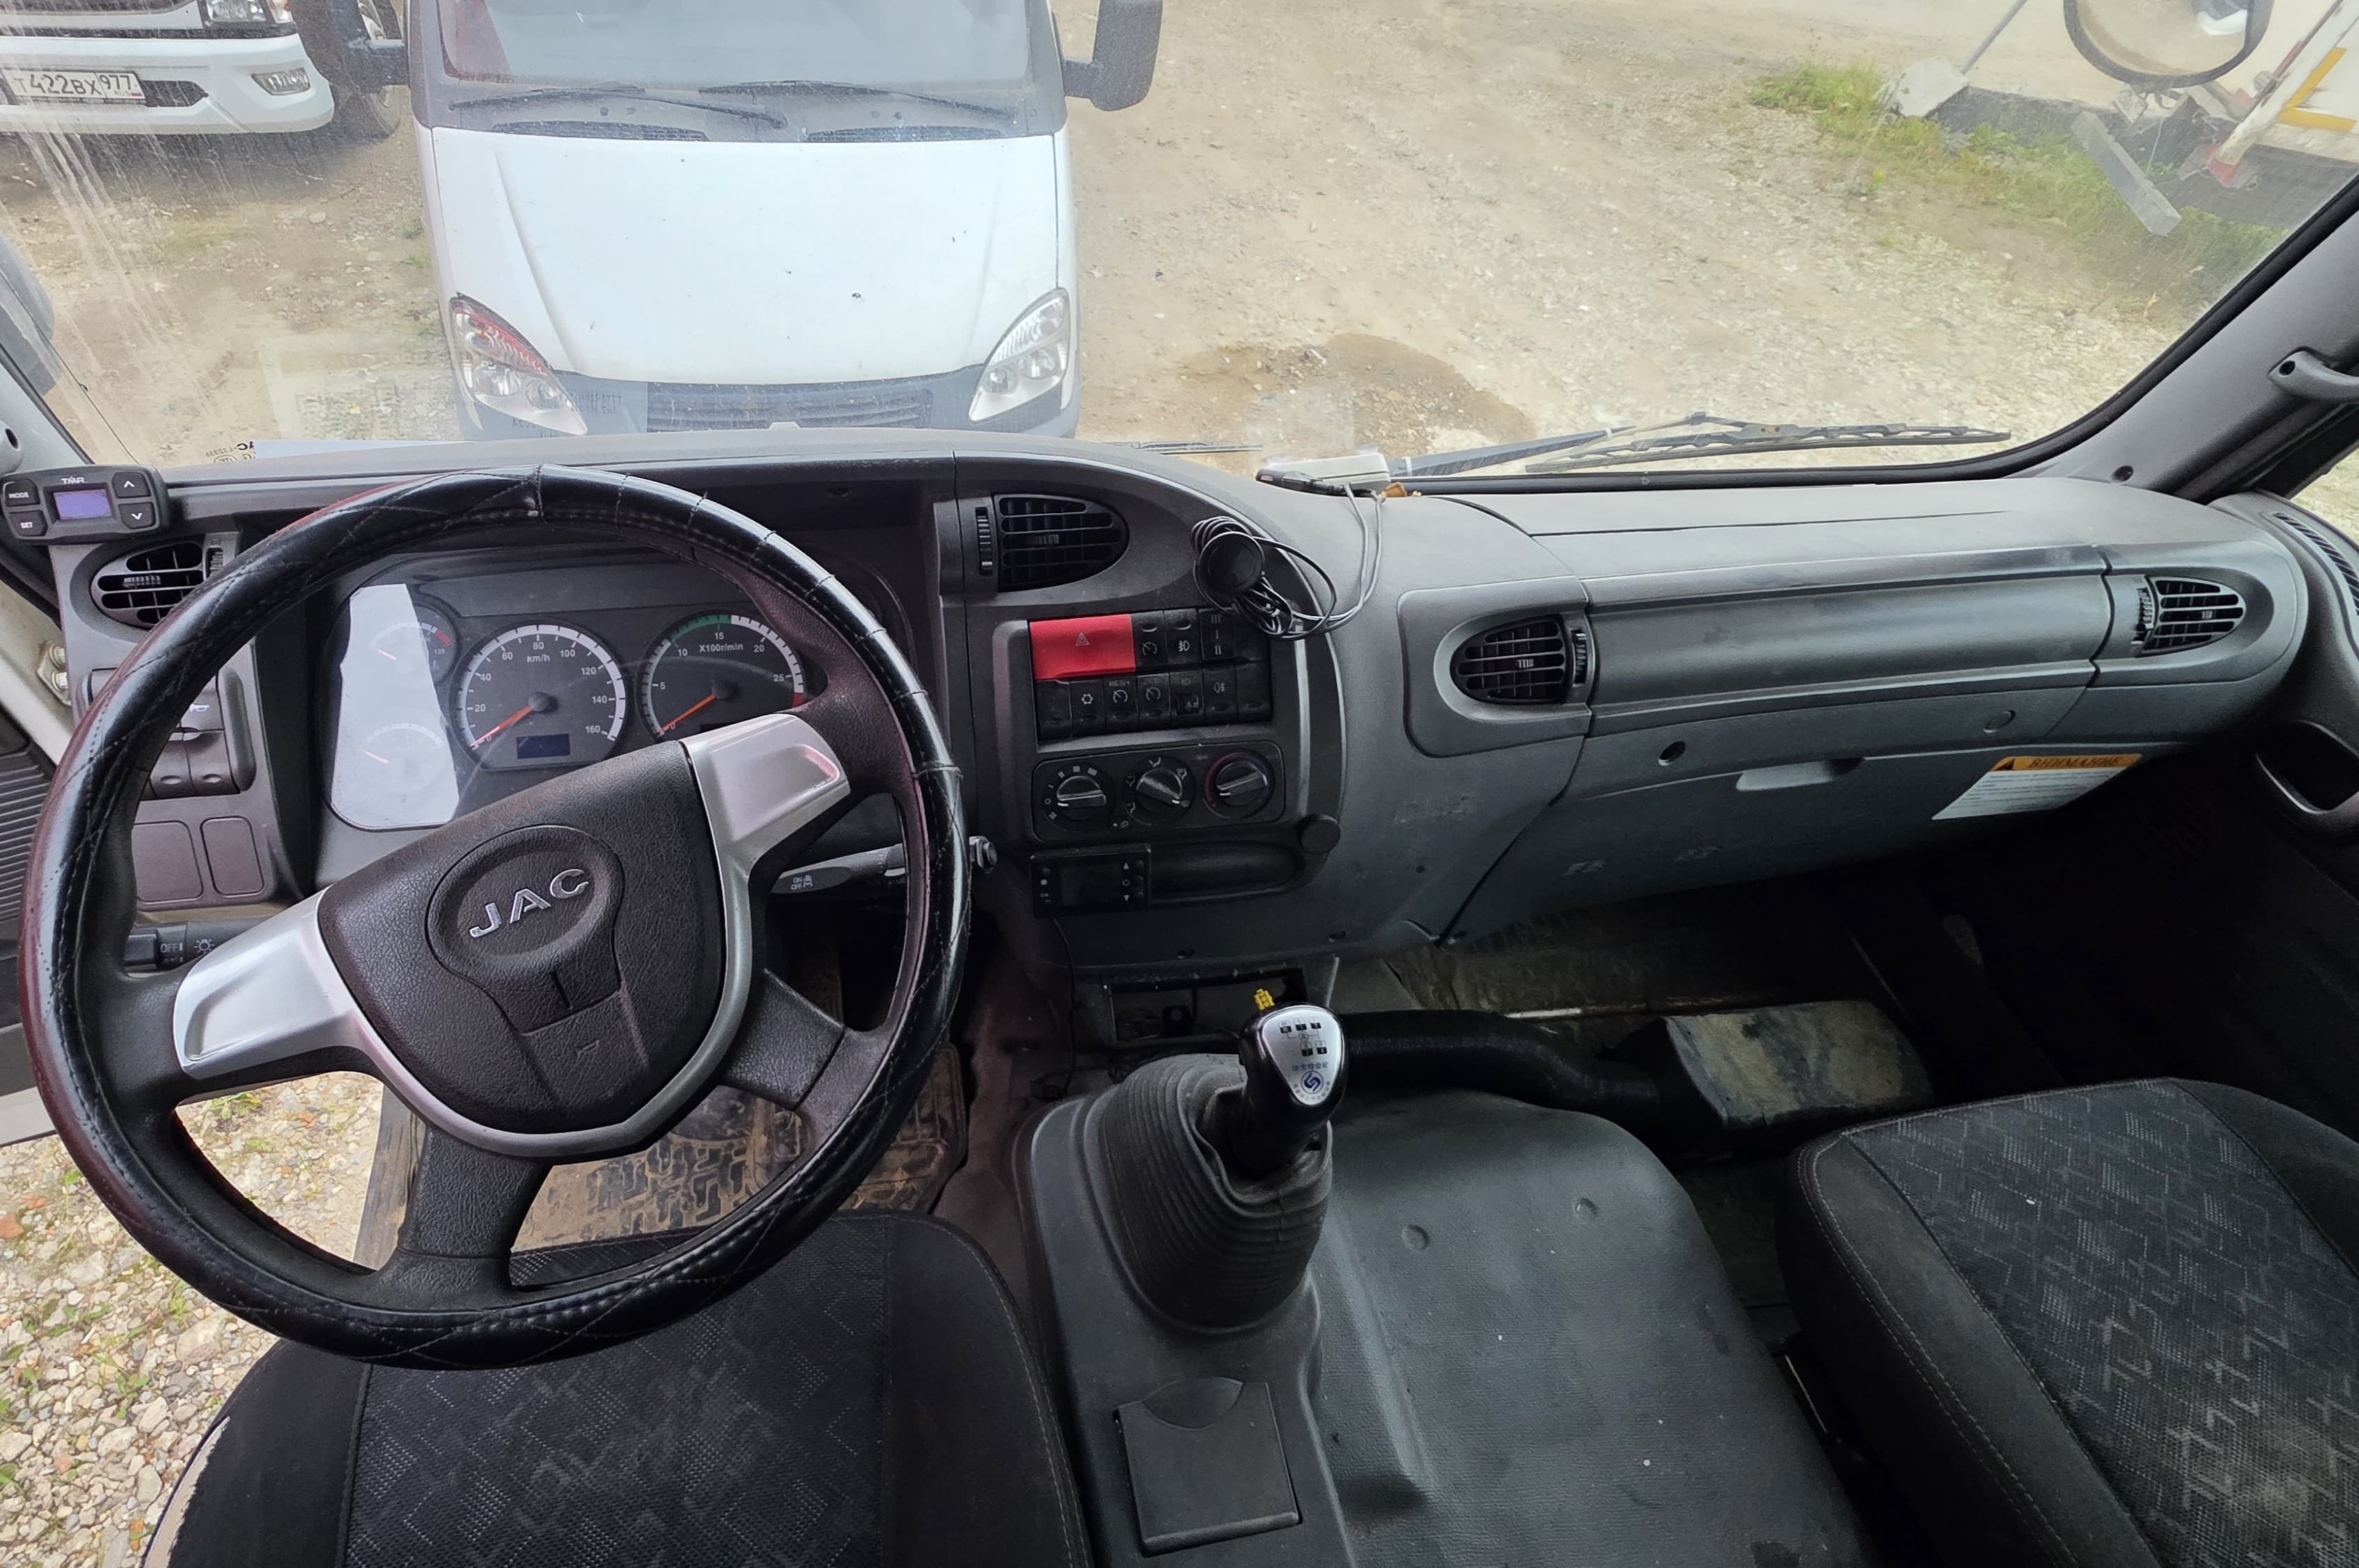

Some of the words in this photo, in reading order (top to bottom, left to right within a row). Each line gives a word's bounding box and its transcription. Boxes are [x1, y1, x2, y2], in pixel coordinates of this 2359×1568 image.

[100, 75, 131, 90] 977
[714, 632, 724, 641] 15
[533, 641, 544, 650] 80
[754, 644, 765, 653] 20
[502, 652, 513, 660] 60
[560, 649, 576, 658] 100
[677, 648, 688, 657] 10
[527, 653, 550, 663] km/h
[581, 666, 597, 675] 120
[480, 673, 492, 682] 40
[774, 673, 785, 682] 25
[475, 704, 486, 712] 20
[586, 725, 601, 734] 160
[469, 868, 589, 939] JAC
[160, 943, 178, 953] OFF
